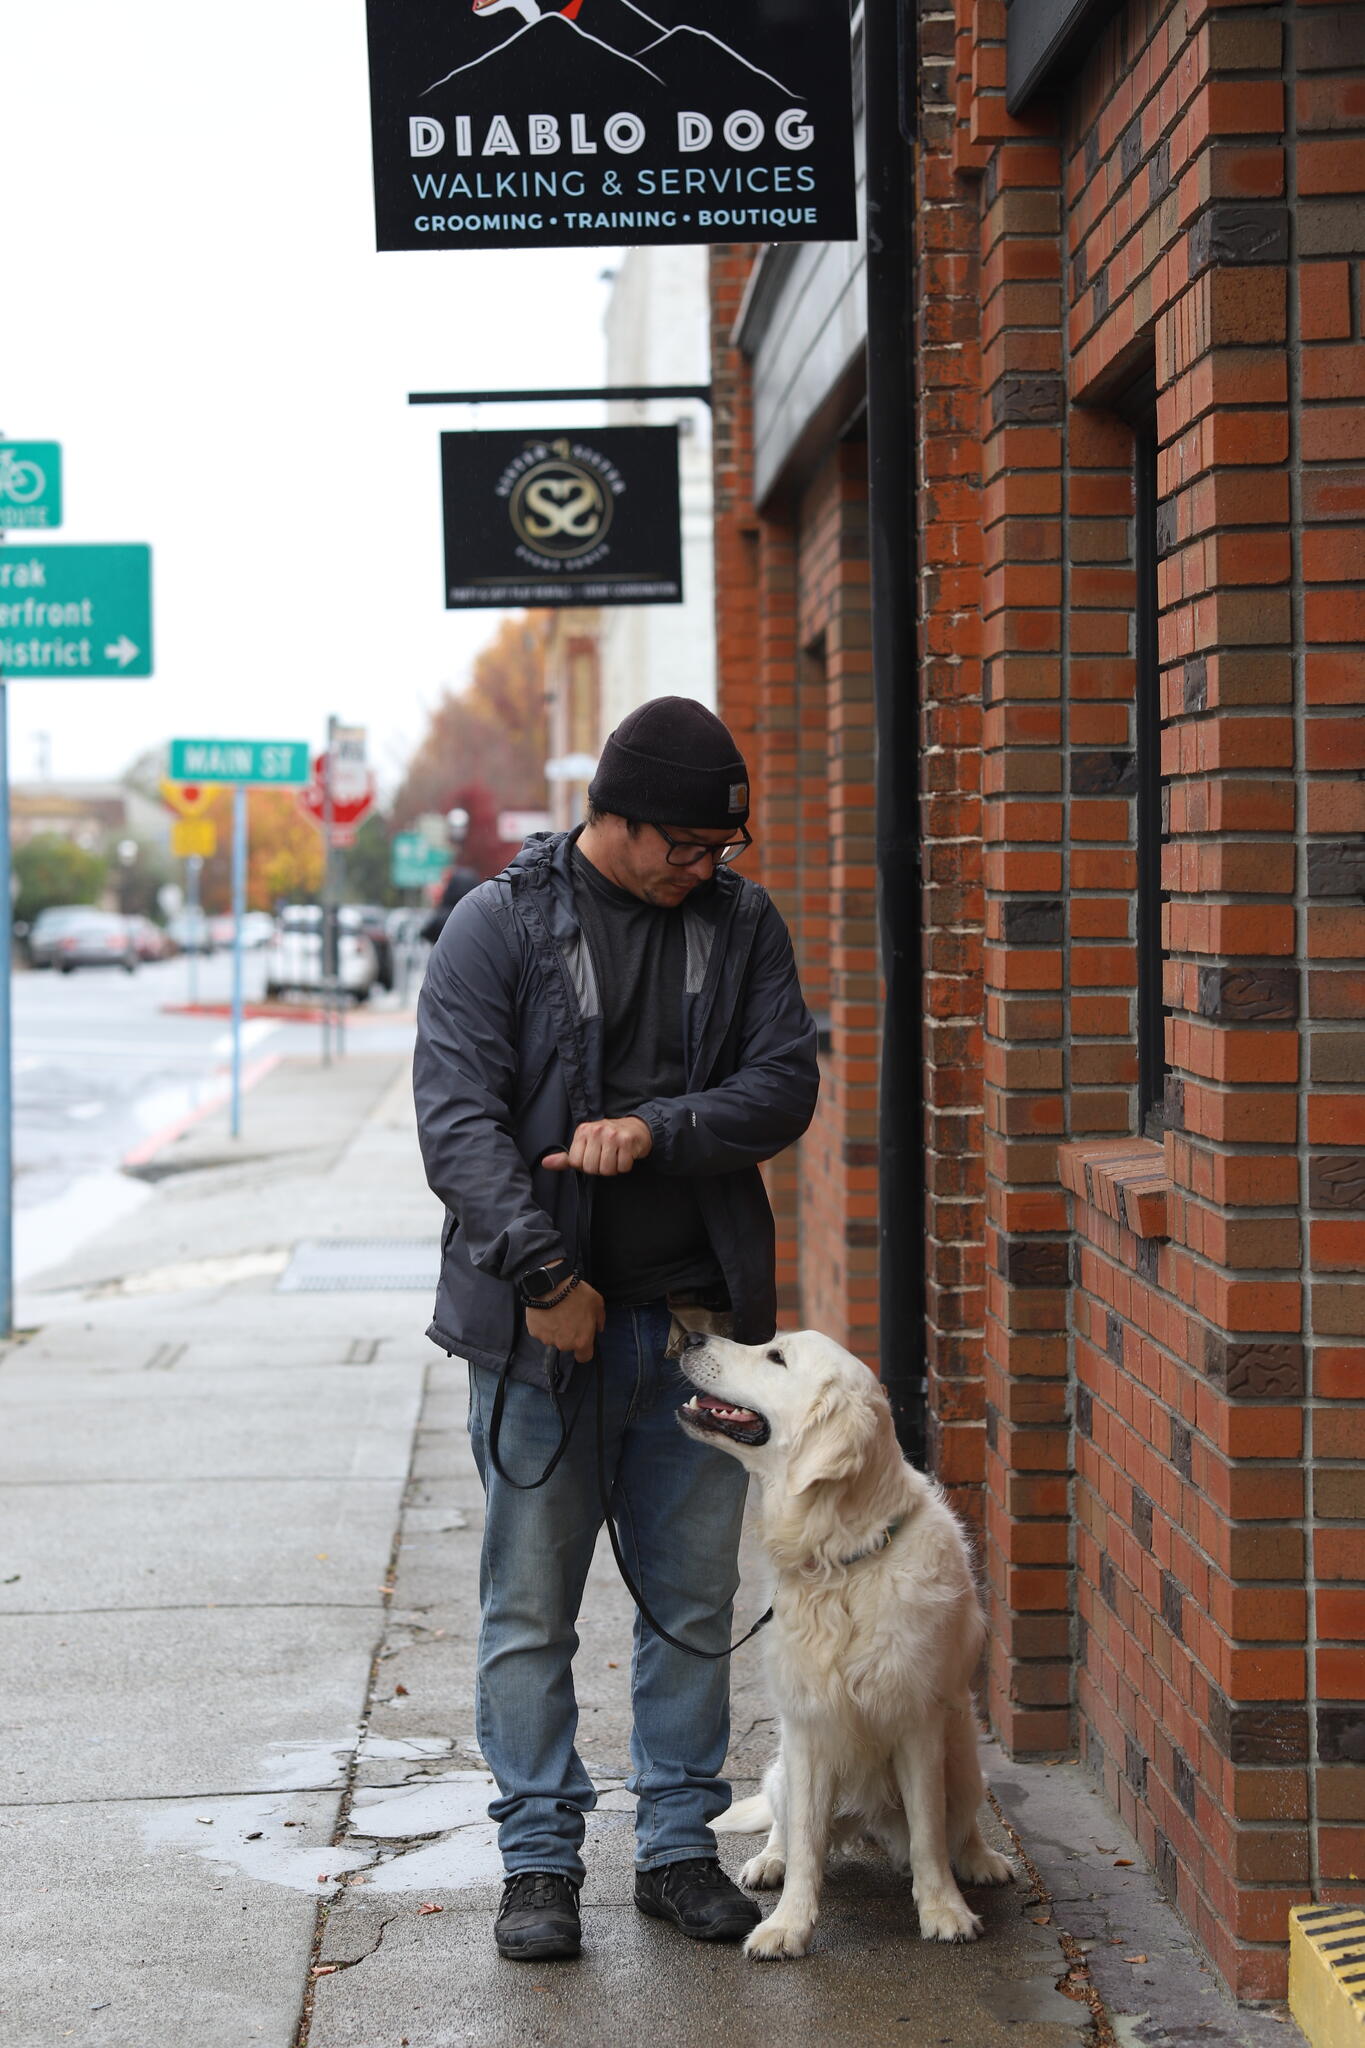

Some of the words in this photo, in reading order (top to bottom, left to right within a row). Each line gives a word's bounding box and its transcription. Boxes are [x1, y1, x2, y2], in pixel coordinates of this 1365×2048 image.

[409, 112, 645, 157] DIABLO
[678, 109, 814, 152] DOG
[412, 171, 584, 199] WALKING
[602, 171, 622, 195] &
[638, 167, 814, 194] SERVICES
[415, 214, 542, 231] GROOMING
[564, 211, 676, 228] TRAINING
[699, 208, 817, 227] BOUTIQUE
[0, 637, 92, 667] istrict
[183, 744, 252, 775] MAIN
[260, 745, 294, 777] ST
